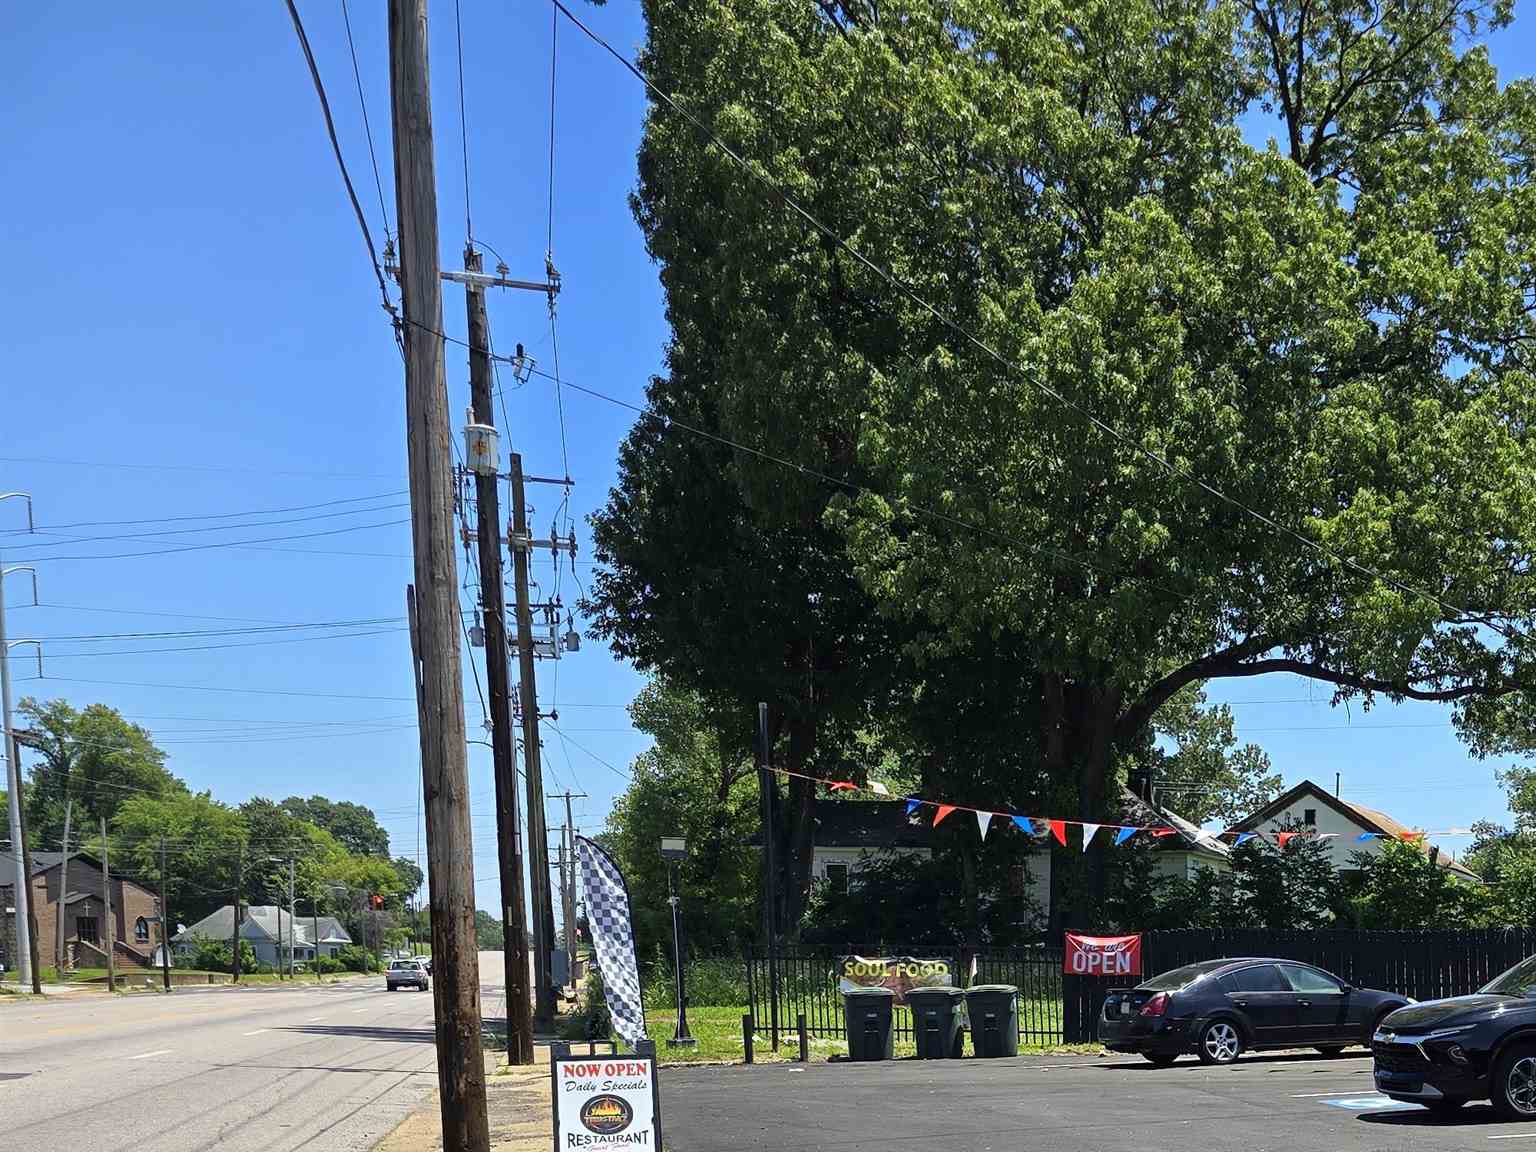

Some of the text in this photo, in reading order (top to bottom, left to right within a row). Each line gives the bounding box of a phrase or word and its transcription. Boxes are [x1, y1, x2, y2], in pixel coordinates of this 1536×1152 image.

[845, 960, 949, 977] SOUL FOOD
[1073, 952, 1131, 974] OPEN
[563, 1062, 647, 1078] NOW OPEN
[565, 1079, 647, 1093] Daily Specials
[568, 1130, 648, 1148] RESTAURANT
